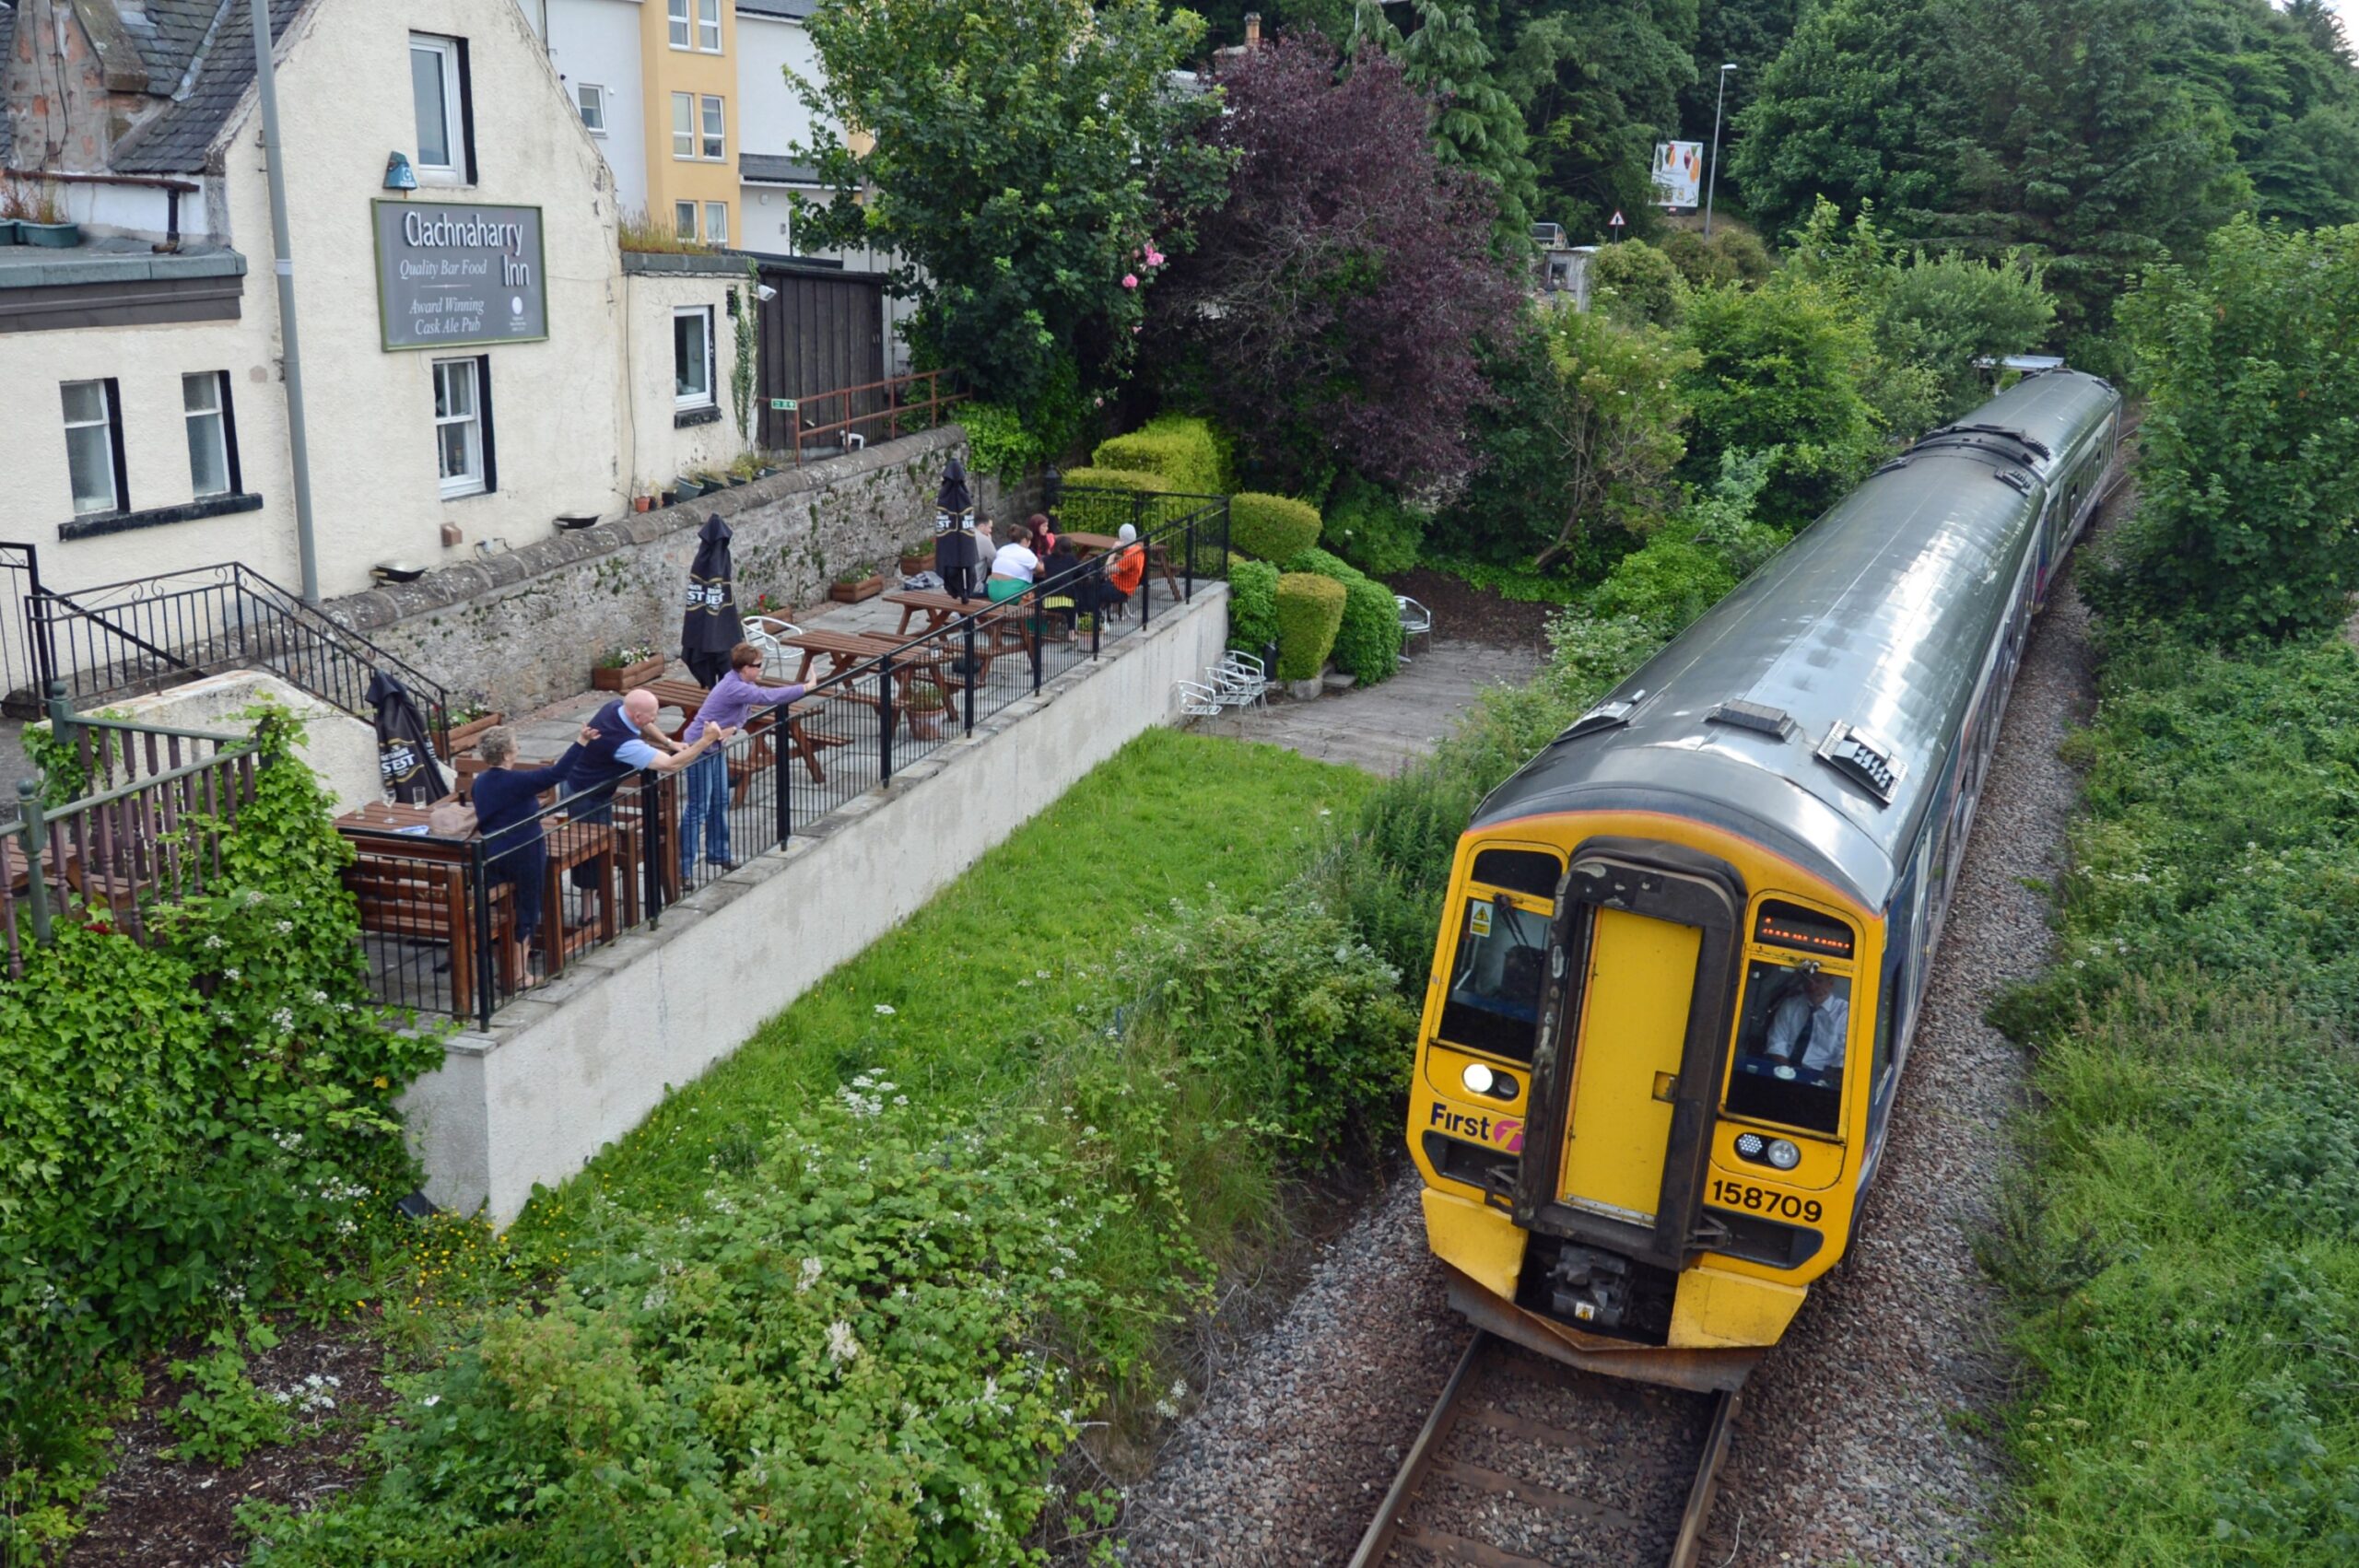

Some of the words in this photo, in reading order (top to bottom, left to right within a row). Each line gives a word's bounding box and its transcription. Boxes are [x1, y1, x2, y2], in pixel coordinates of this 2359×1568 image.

[405, 211, 523, 257] Clachnaharry
[400, 259, 439, 280] Quality
[440, 259, 460, 275] Bar
[462, 258, 487, 275] Food
[502, 253, 530, 287] Inn
[408, 297, 442, 314] Award
[445, 296, 485, 315] Winning
[415, 318, 440, 335] Cask
[442, 317, 459, 333] Ale
[462, 315, 481, 333] Pub
[1430, 1102, 1491, 1141] First
[1713, 1179, 1823, 1223] 158709
